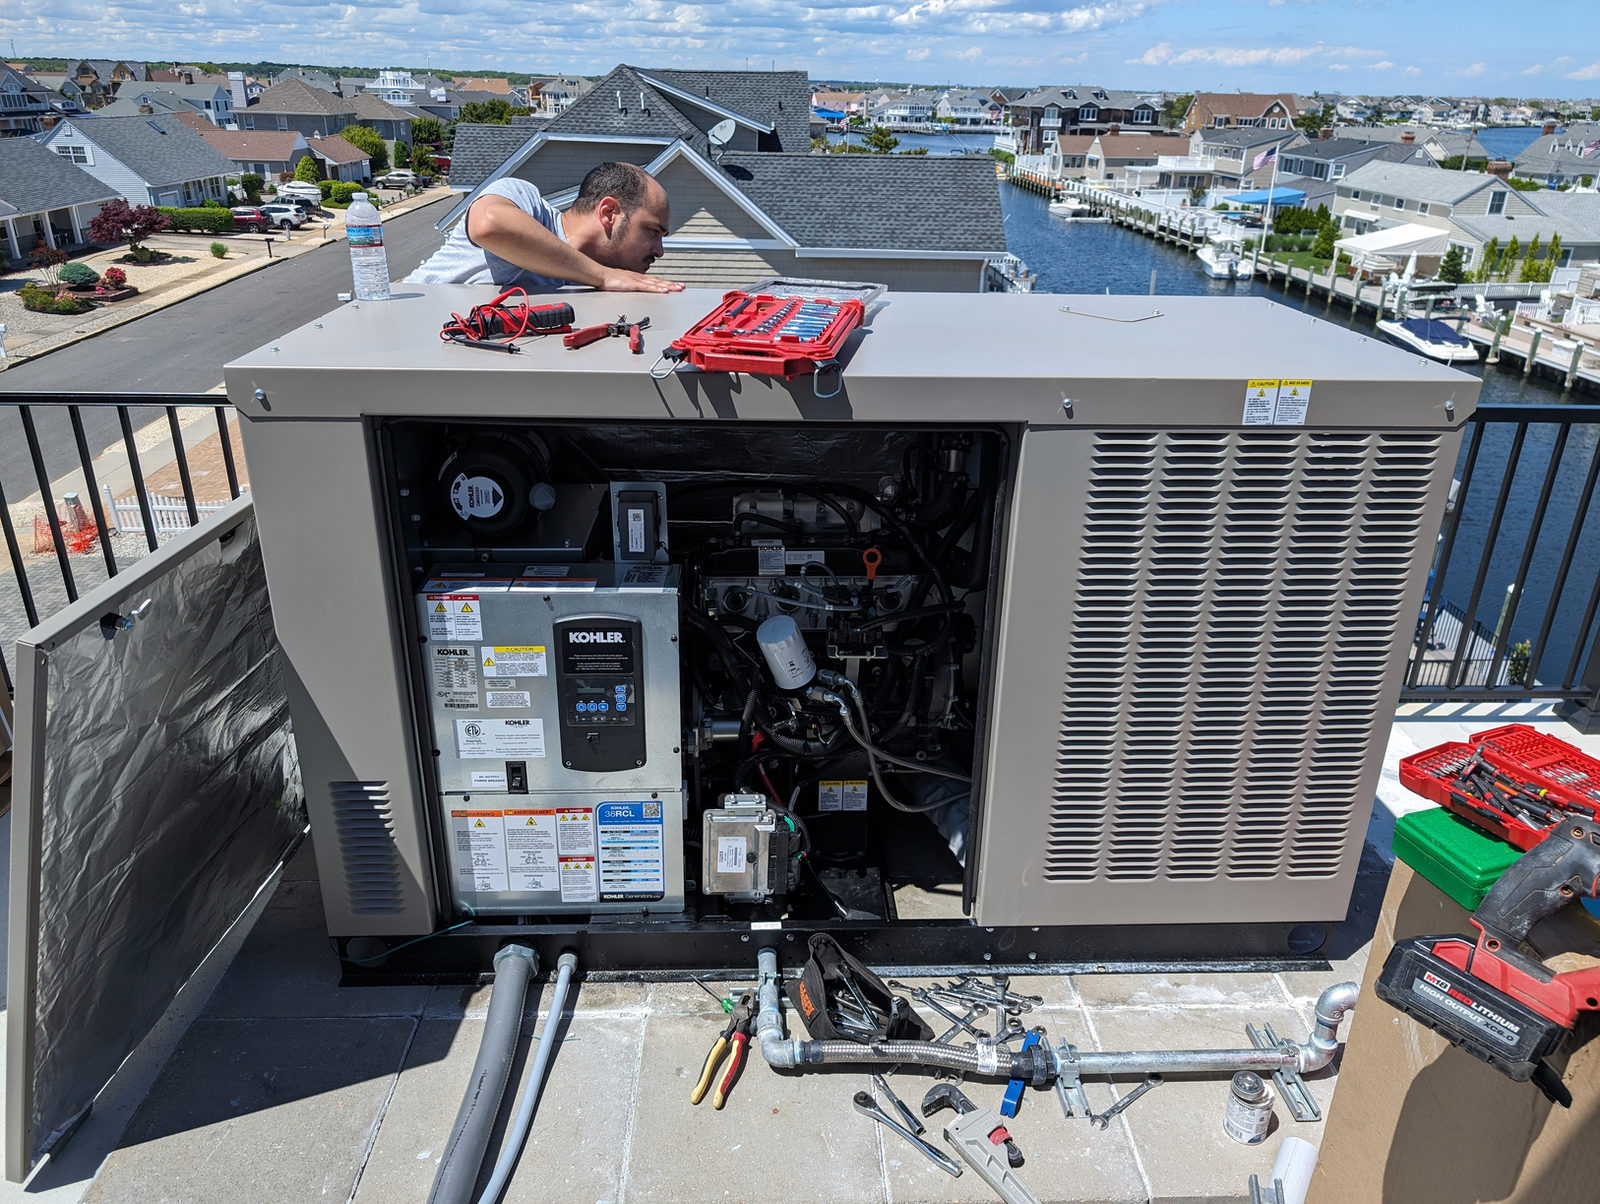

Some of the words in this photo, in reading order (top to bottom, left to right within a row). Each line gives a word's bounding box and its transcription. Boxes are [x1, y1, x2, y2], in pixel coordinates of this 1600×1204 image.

[1426, 974, 1448, 990] M18
[1420, 984, 1444, 1000] HIGH
[1444, 999, 1484, 1023] OUTPUT
[1484, 1022, 1514, 1041] XC6.0
